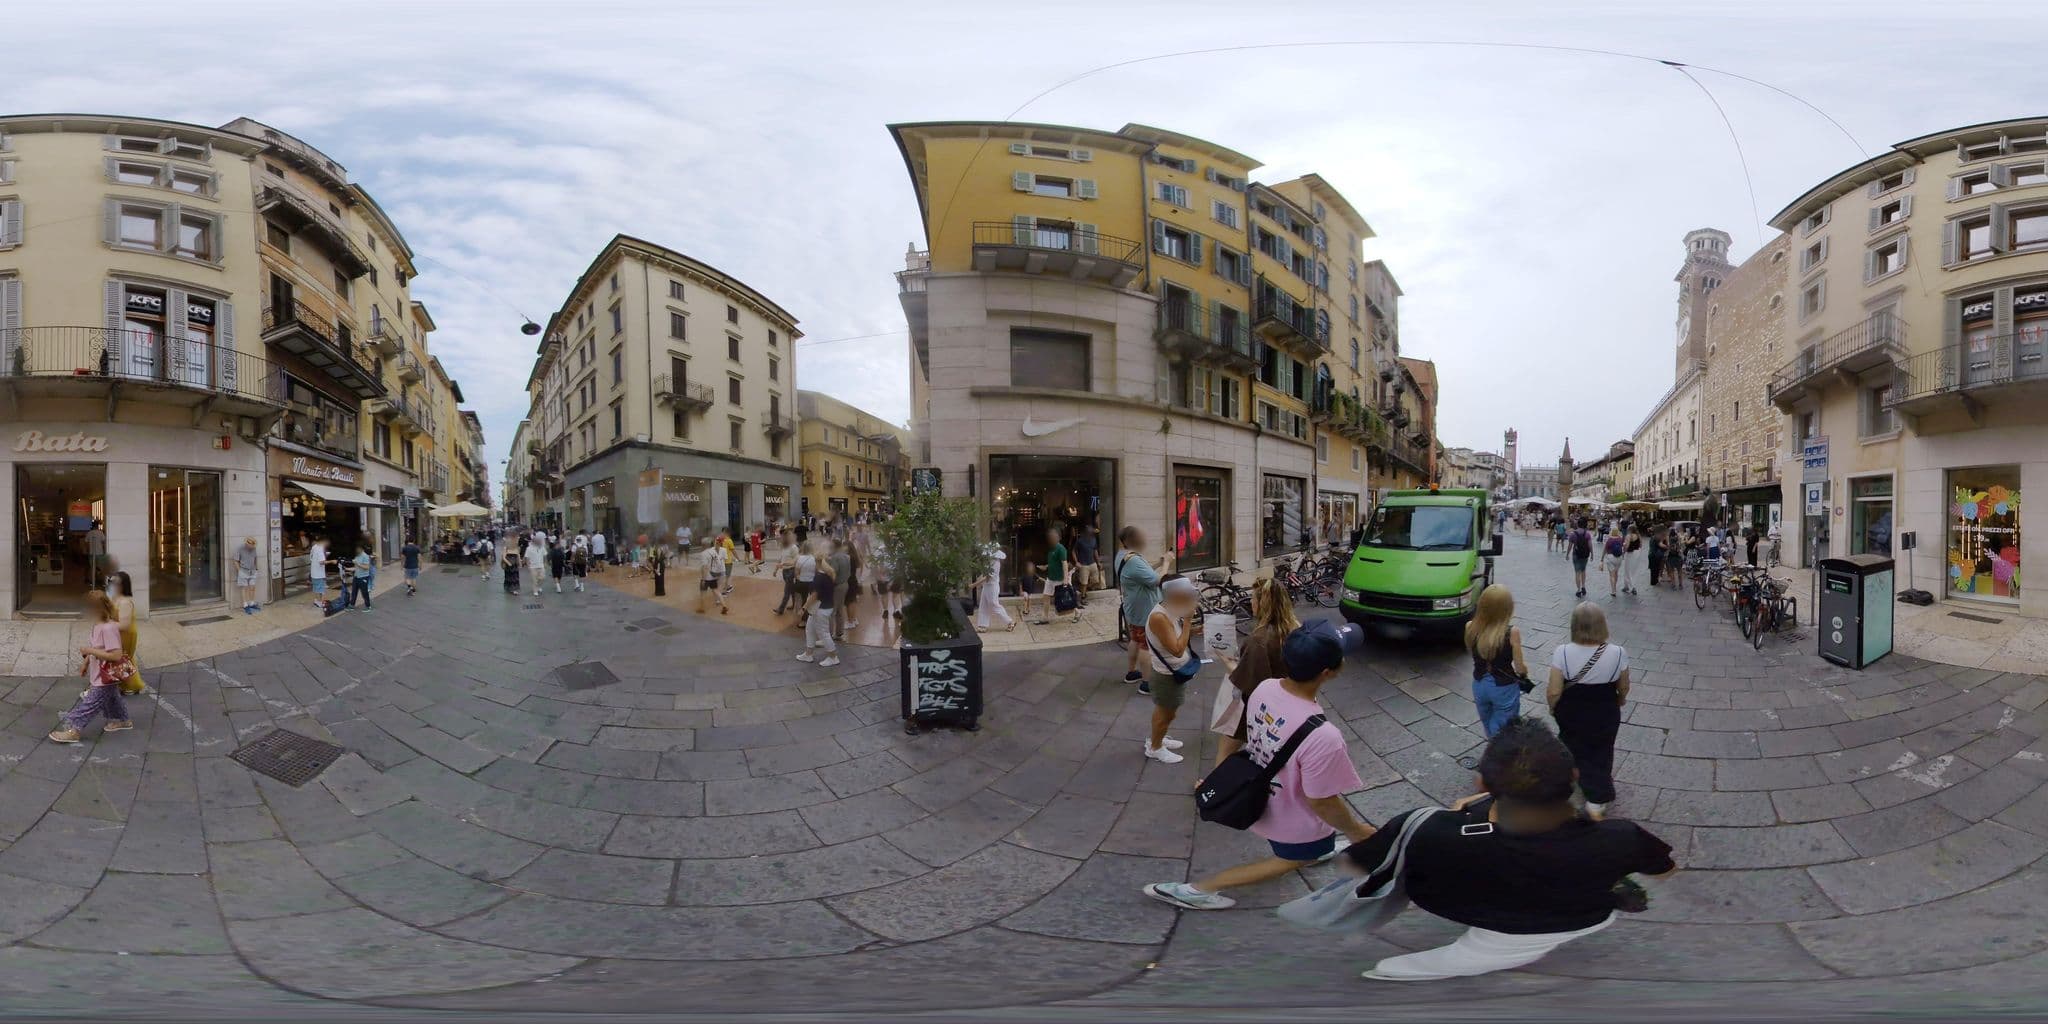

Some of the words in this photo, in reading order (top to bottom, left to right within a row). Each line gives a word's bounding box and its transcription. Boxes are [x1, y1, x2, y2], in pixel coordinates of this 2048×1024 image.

[130, 295, 162, 306] KFC
[2014, 293, 2046, 305] KFC
[1963, 302, 1992, 316] KFC
[13, 430, 109, 452] Bata
